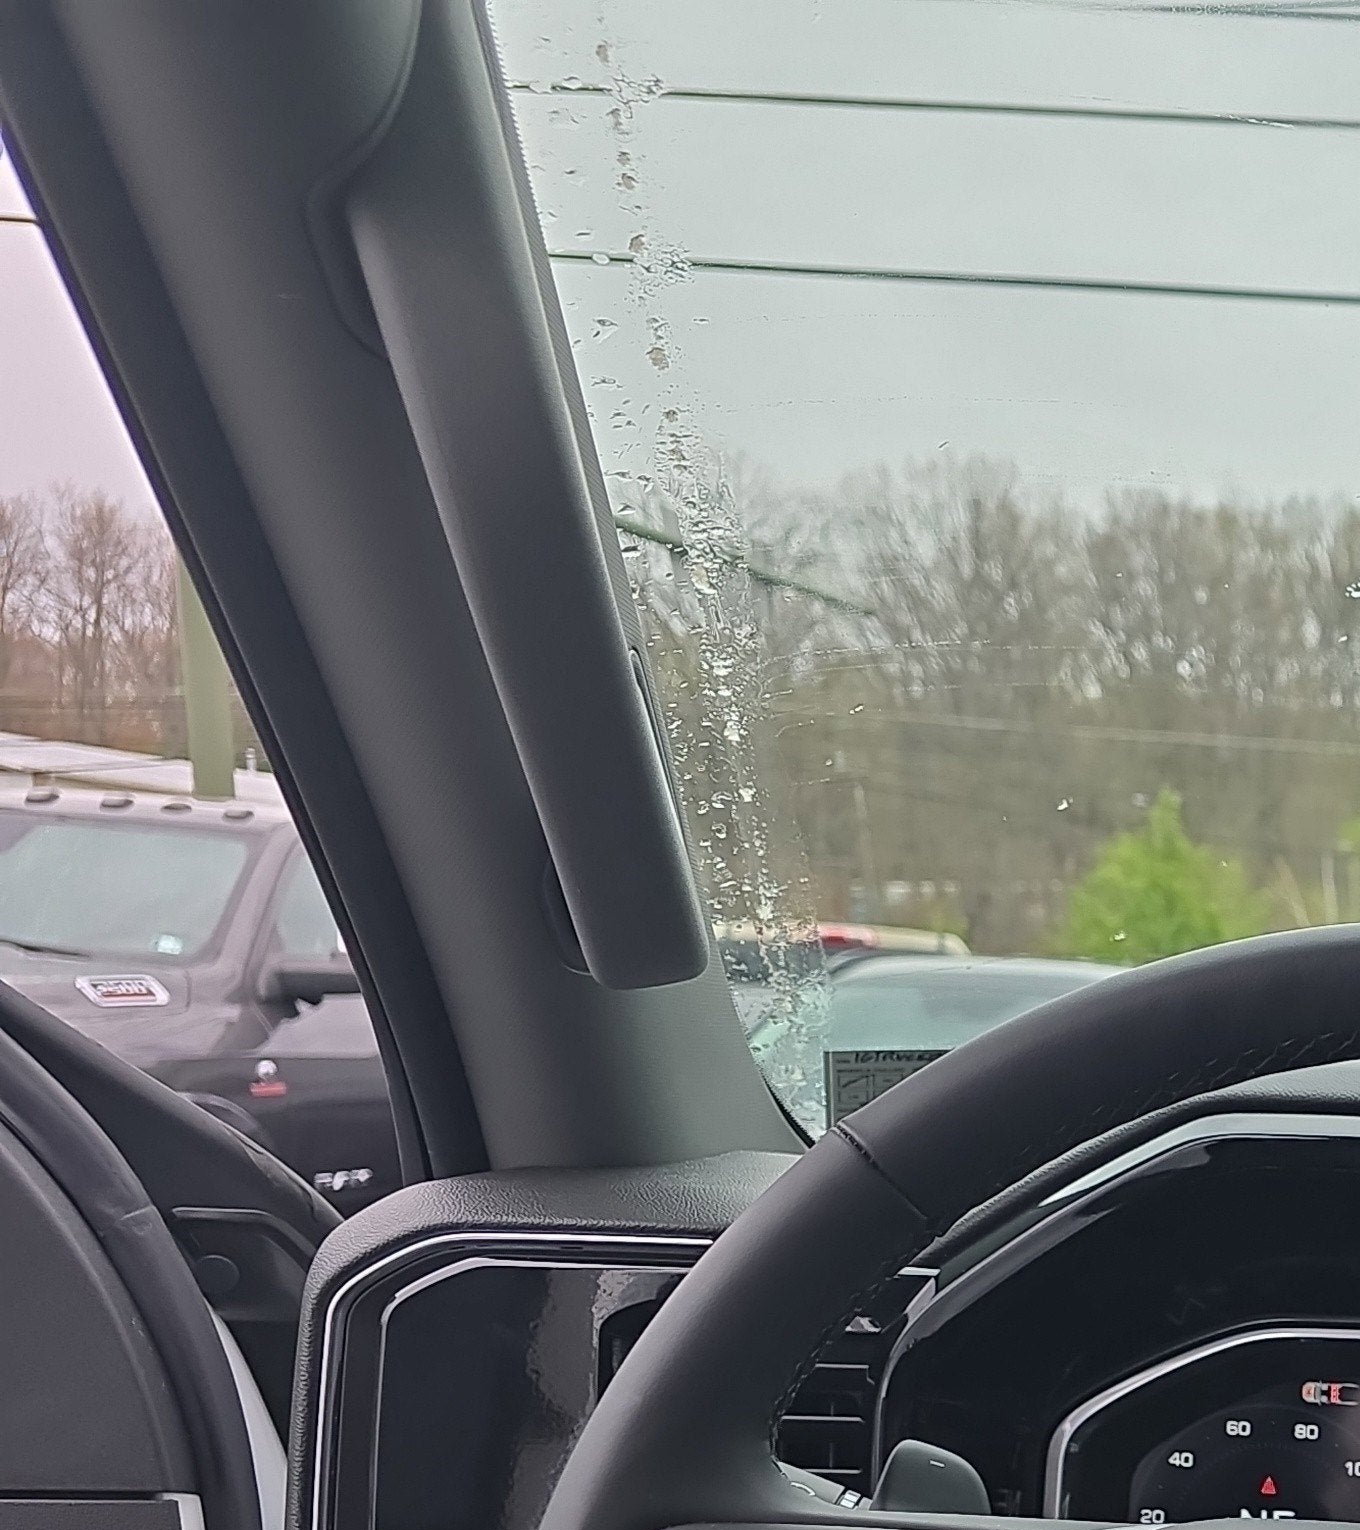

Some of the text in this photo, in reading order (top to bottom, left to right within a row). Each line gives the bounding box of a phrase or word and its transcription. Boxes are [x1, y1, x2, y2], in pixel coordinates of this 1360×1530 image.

[1226, 1420, 1251, 1436] 60
[1294, 1424, 1319, 1440] 80
[1168, 1452, 1194, 1468] 40
[1139, 1509, 1165, 1525] 20
